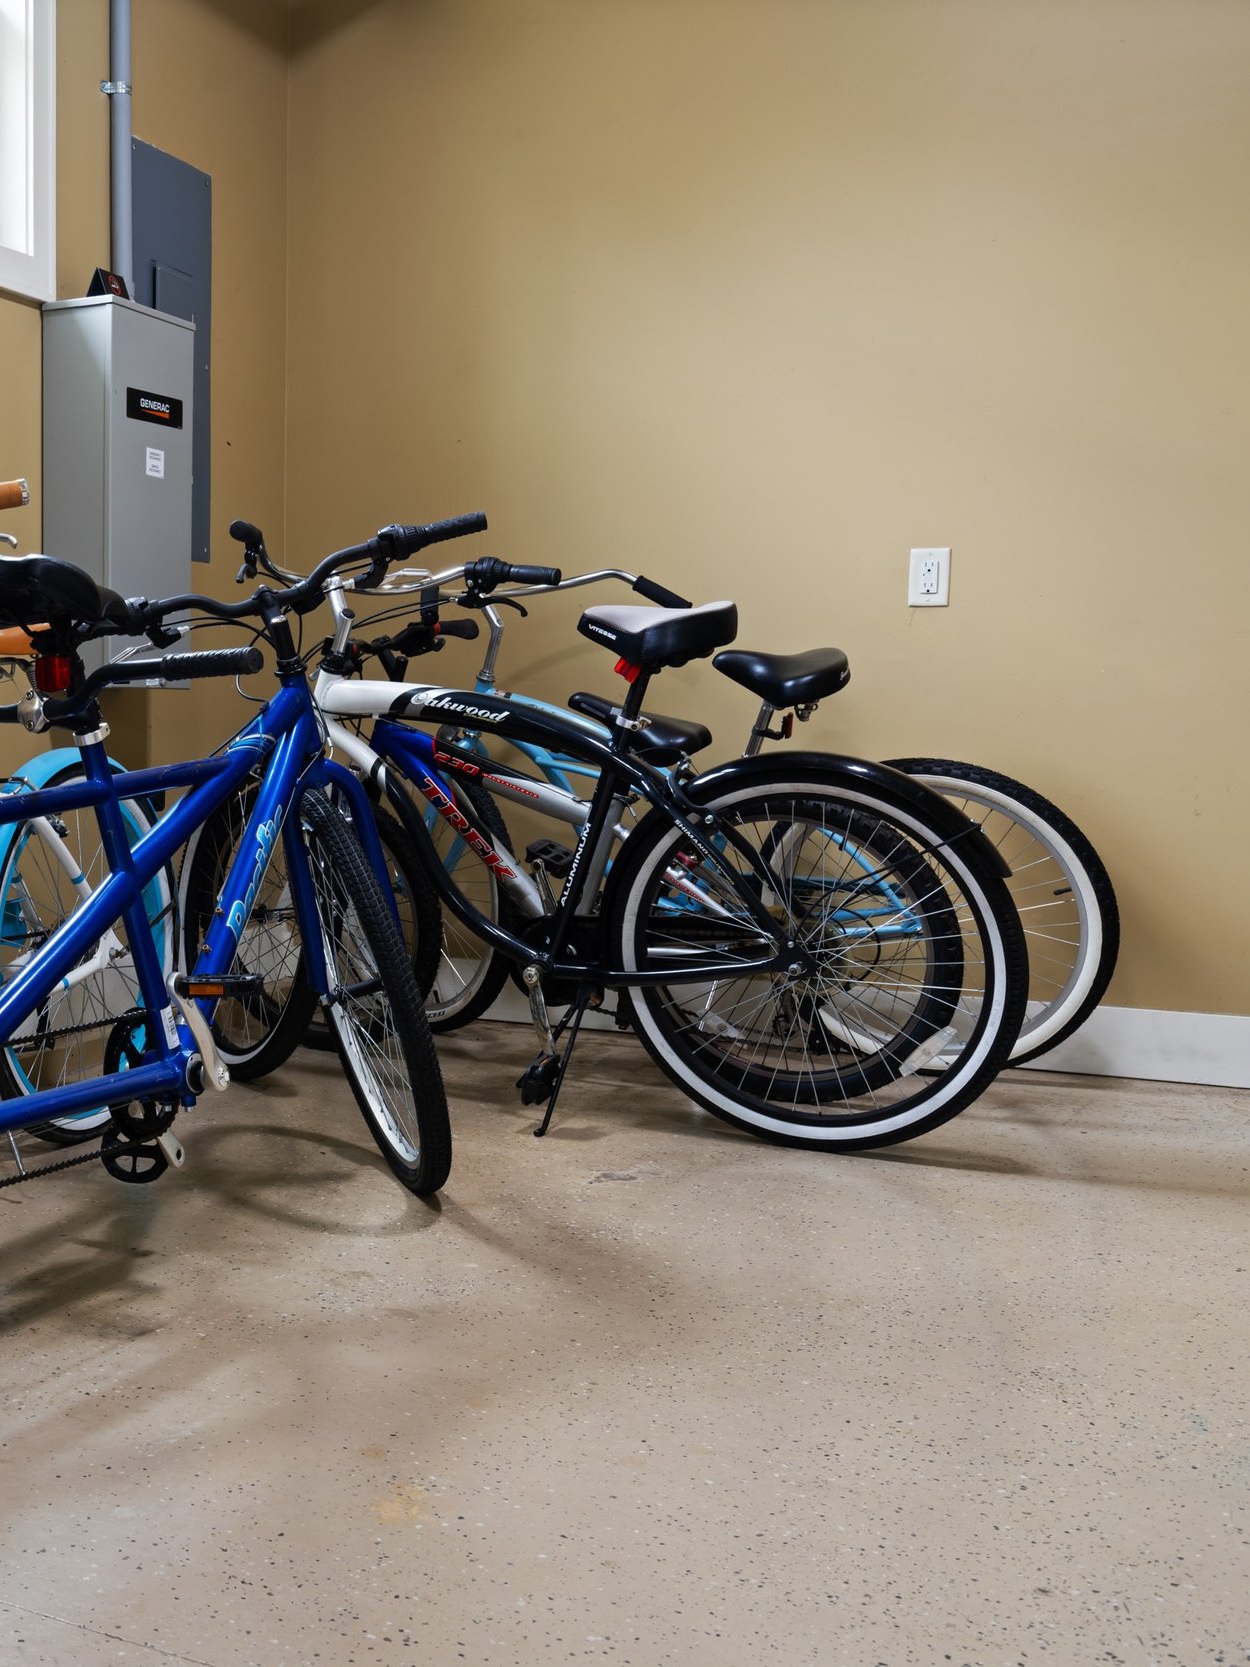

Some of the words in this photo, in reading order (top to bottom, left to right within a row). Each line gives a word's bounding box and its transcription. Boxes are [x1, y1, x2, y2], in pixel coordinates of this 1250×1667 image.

[139, 397, 170, 413] GENERAC
[588, 623, 617, 641] VITESSE
[410, 692, 511, 723] Oakwood
[433, 750, 481, 777] 230
[420, 777, 517, 882] TREK
[674, 819, 708, 855] SHIMANO
[561, 822, 591, 907] ALUMINUM
